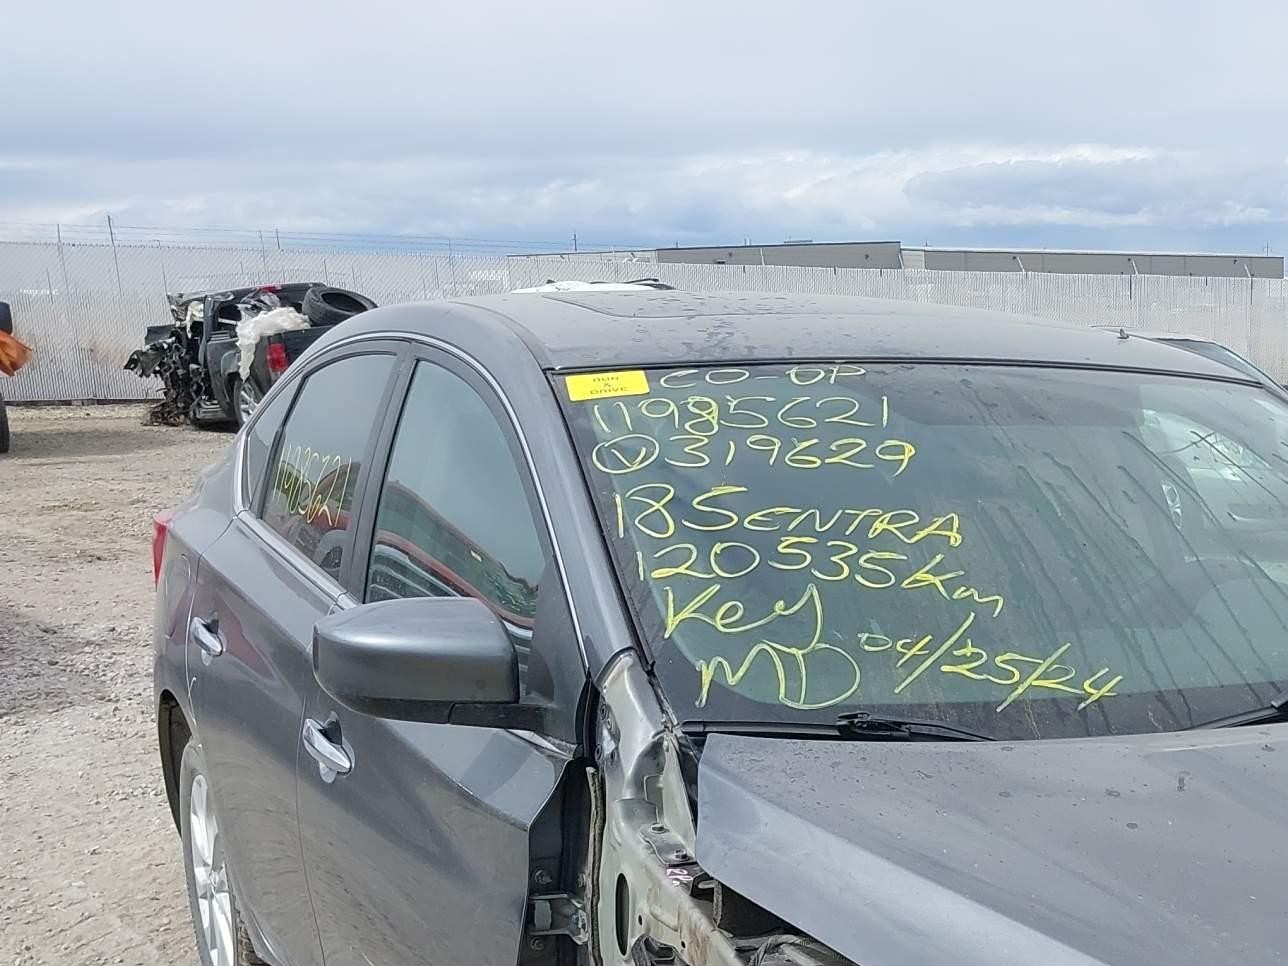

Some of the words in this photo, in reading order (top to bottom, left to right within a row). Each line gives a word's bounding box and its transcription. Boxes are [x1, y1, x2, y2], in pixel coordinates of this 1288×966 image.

[659, 364, 866, 389] CO-OP
[593, 396, 890, 436] 11985621
[662, 583, 824, 654] Key
[857, 611, 1124, 712] 04/25/24
